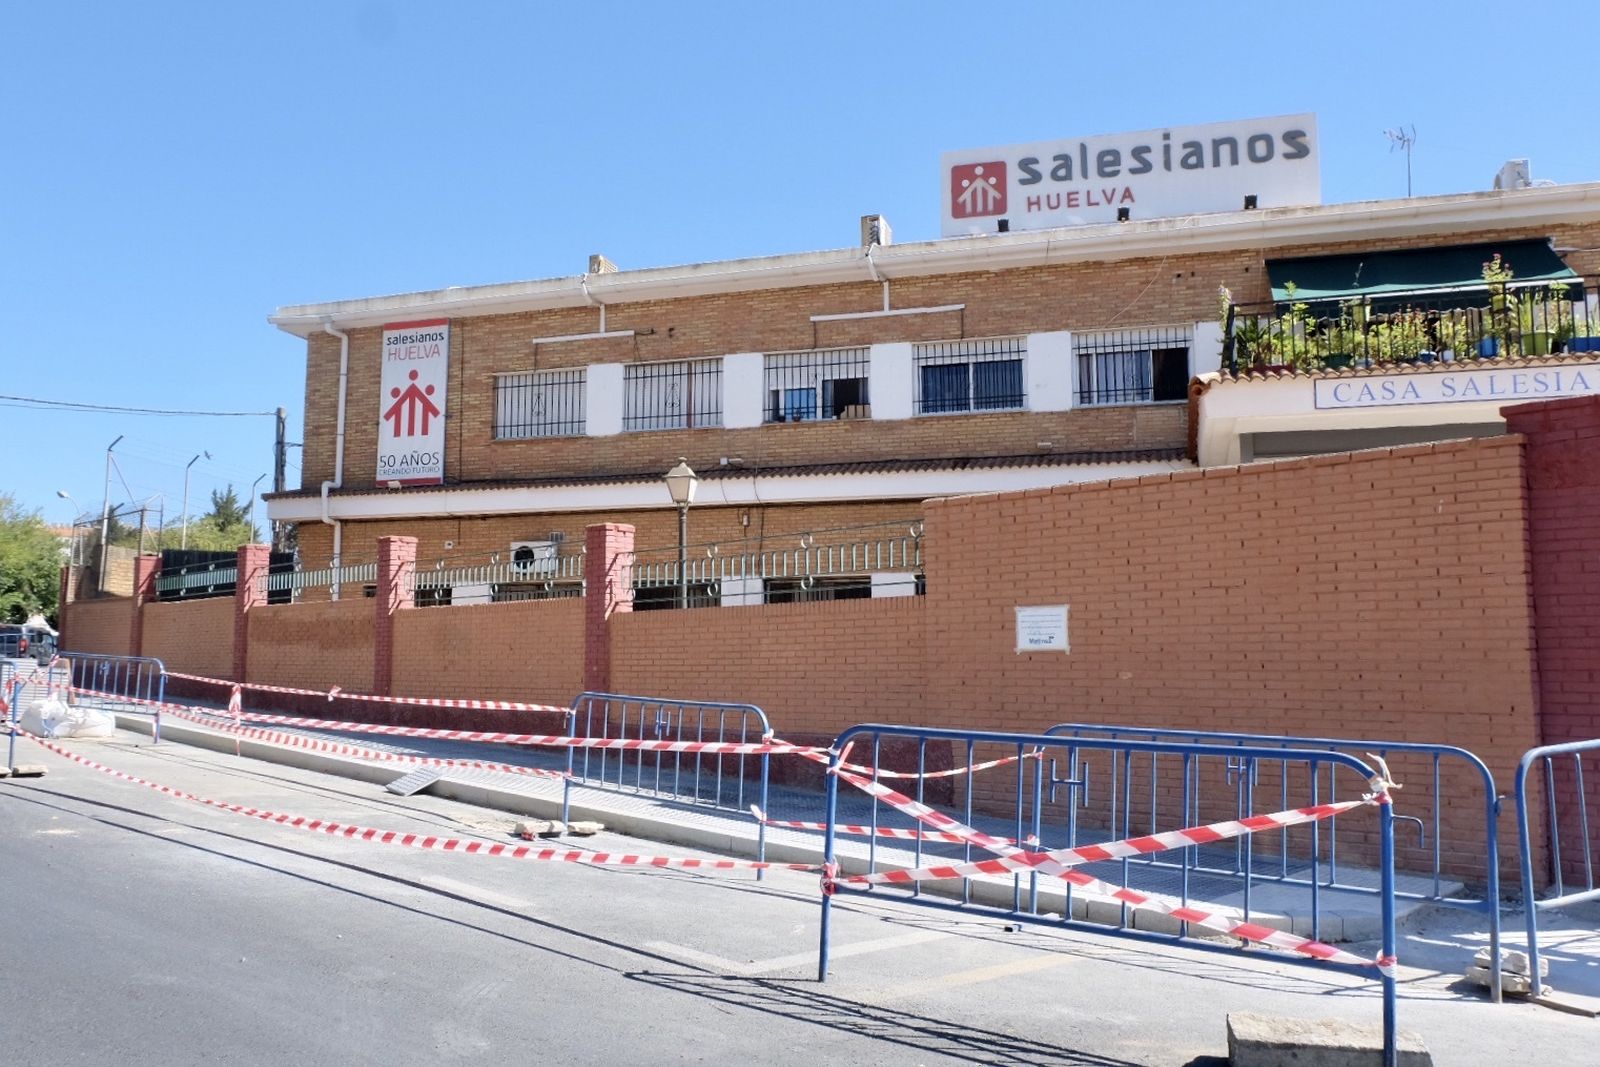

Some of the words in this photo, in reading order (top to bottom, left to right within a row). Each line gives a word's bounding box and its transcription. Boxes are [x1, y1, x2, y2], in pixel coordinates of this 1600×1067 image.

[1017, 129, 1310, 185] salesianos
[1027, 186, 1135, 212] HUELVA
[386, 331, 445, 346] salesianos
[387, 344, 441, 361] HUELVA
[1333, 380, 1421, 402] CASA
[1441, 370, 1600, 397] SALESIA
[379, 454, 396, 468] 50
[399, 450, 440, 467] AÑOS
[378, 467, 412, 476] CREANDO
[412, 466, 440, 474] FUTURO
